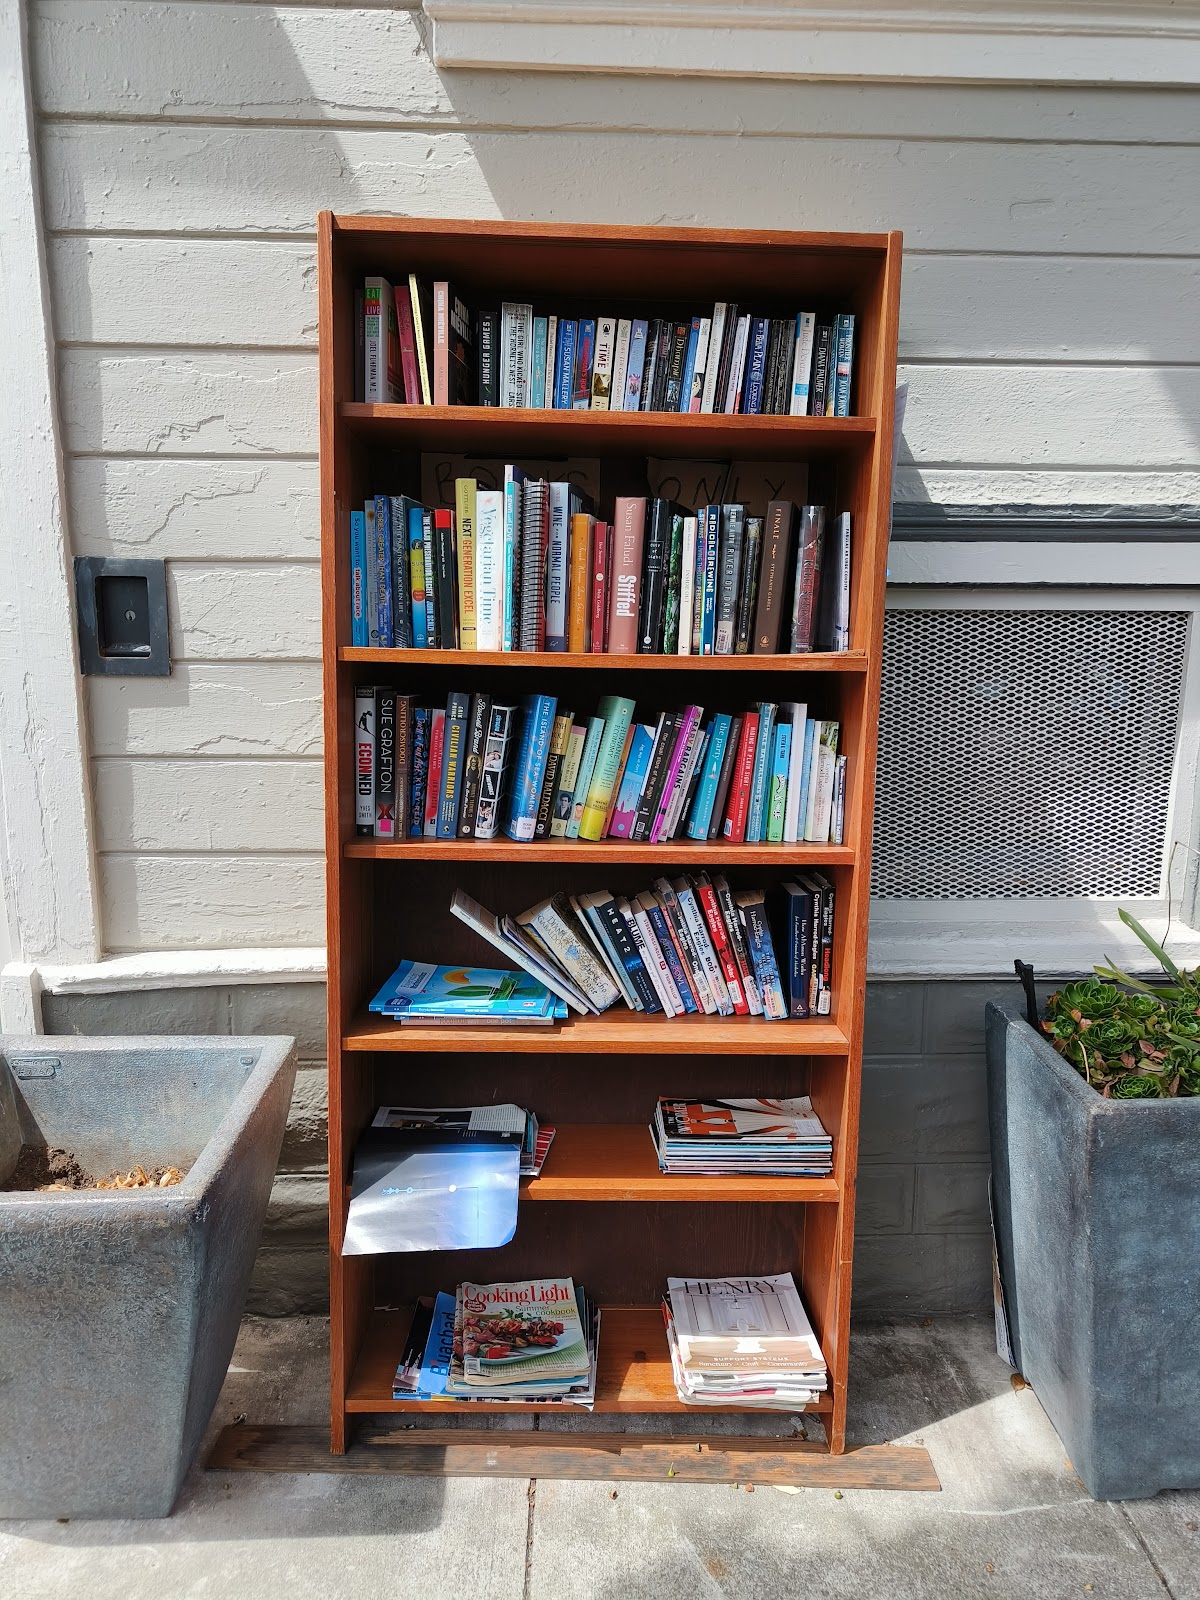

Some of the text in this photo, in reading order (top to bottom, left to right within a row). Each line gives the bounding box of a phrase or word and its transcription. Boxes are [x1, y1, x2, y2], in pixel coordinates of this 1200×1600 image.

[366, 289, 380, 298] EAT
[366, 306, 380, 314] LIVE
[482, 322, 490, 384] HUNGER GAMES
[712, 338, 718, 347] WE
[802, 330, 811, 346] Jude
[597, 343, 608, 368] TIME
[672, 339, 684, 376] Dhampir
[752, 352, 763, 370] PLAIN
[799, 348, 809, 382] Deveraux
[815, 347, 826, 392] DIANA PALMER
[561, 347, 571, 404] SUSAN MALLERY
[706, 378, 714, 406] MARRIED
[751, 382, 760, 408] LOOKING
[354, 518, 360, 526] So
[552, 506, 563, 527] WINE
[772, 508, 782, 540] FINALE
[479, 508, 497, 584] Vegetarian
[622, 502, 637, 567] Susan Faludi
[422, 516, 433, 597] THE PRESERVATION SOCIETY
[462, 518, 474, 614] NEXT GENERATION EXCEL
[552, 540, 562, 572] NORMAL
[551, 576, 561, 604] PEOPLE
[616, 574, 637, 617] Stiffed
[722, 548, 735, 619] RIVER OF DARK
[399, 700, 407, 764] DOOMSCROLLING
[449, 725, 460, 759] CIVILIAN
[472, 699, 486, 755] Russell Brand
[537, 718, 548, 746] ISLAND
[608, 724, 620, 758] ECONOMY
[614, 726, 627, 759] HUMANE
[687, 722, 699, 745] BABY
[711, 722, 727, 760] the party
[748, 727, 756, 745] HIDING
[380, 698, 392, 793] SUE GRAFTON
[535, 750, 542, 760] OF
[358, 742, 372, 796] ECONNED
[674, 746, 692, 790] BARGAINS
[745, 754, 754, 770] PLAIN
[756, 748, 766, 794] BATTALIONS
[446, 761, 457, 799] WARRIORS
[538, 755, 558, 821] DAVID BALDACCI
[646, 787, 656, 800] night
[743, 771, 751, 787] SIGHT
[528, 780, 539, 811] WOMEN
[652, 912, 662, 928] COLFER
[707, 890, 720, 918] Cynthia
[725, 893, 744, 941] Cynthia Harrod-
[537, 915, 564, 950] GABALDON
[606, 908, 627, 943] HEAT
[627, 918, 646, 950] BLUME
[676, 911, 688, 932] Cynthia
[686, 897, 709, 950] Cynthia Harrod-
[707, 909, 718, 932] Eagles
[724, 910, 735, 932] Eagles
[643, 919, 662, 959] STRENGTHSFINDER
[676, 929, 689, 950] Eagles
[693, 932, 706, 956] Eagles
[660, 938, 683, 986] ARTEMIS FOWL
[667, 1116, 675, 1124] THE
[672, 1102, 690, 1125] YORKER
[464, 1284, 570, 1306] Cooking Light
[682, 1279, 778, 1294] HENRY
